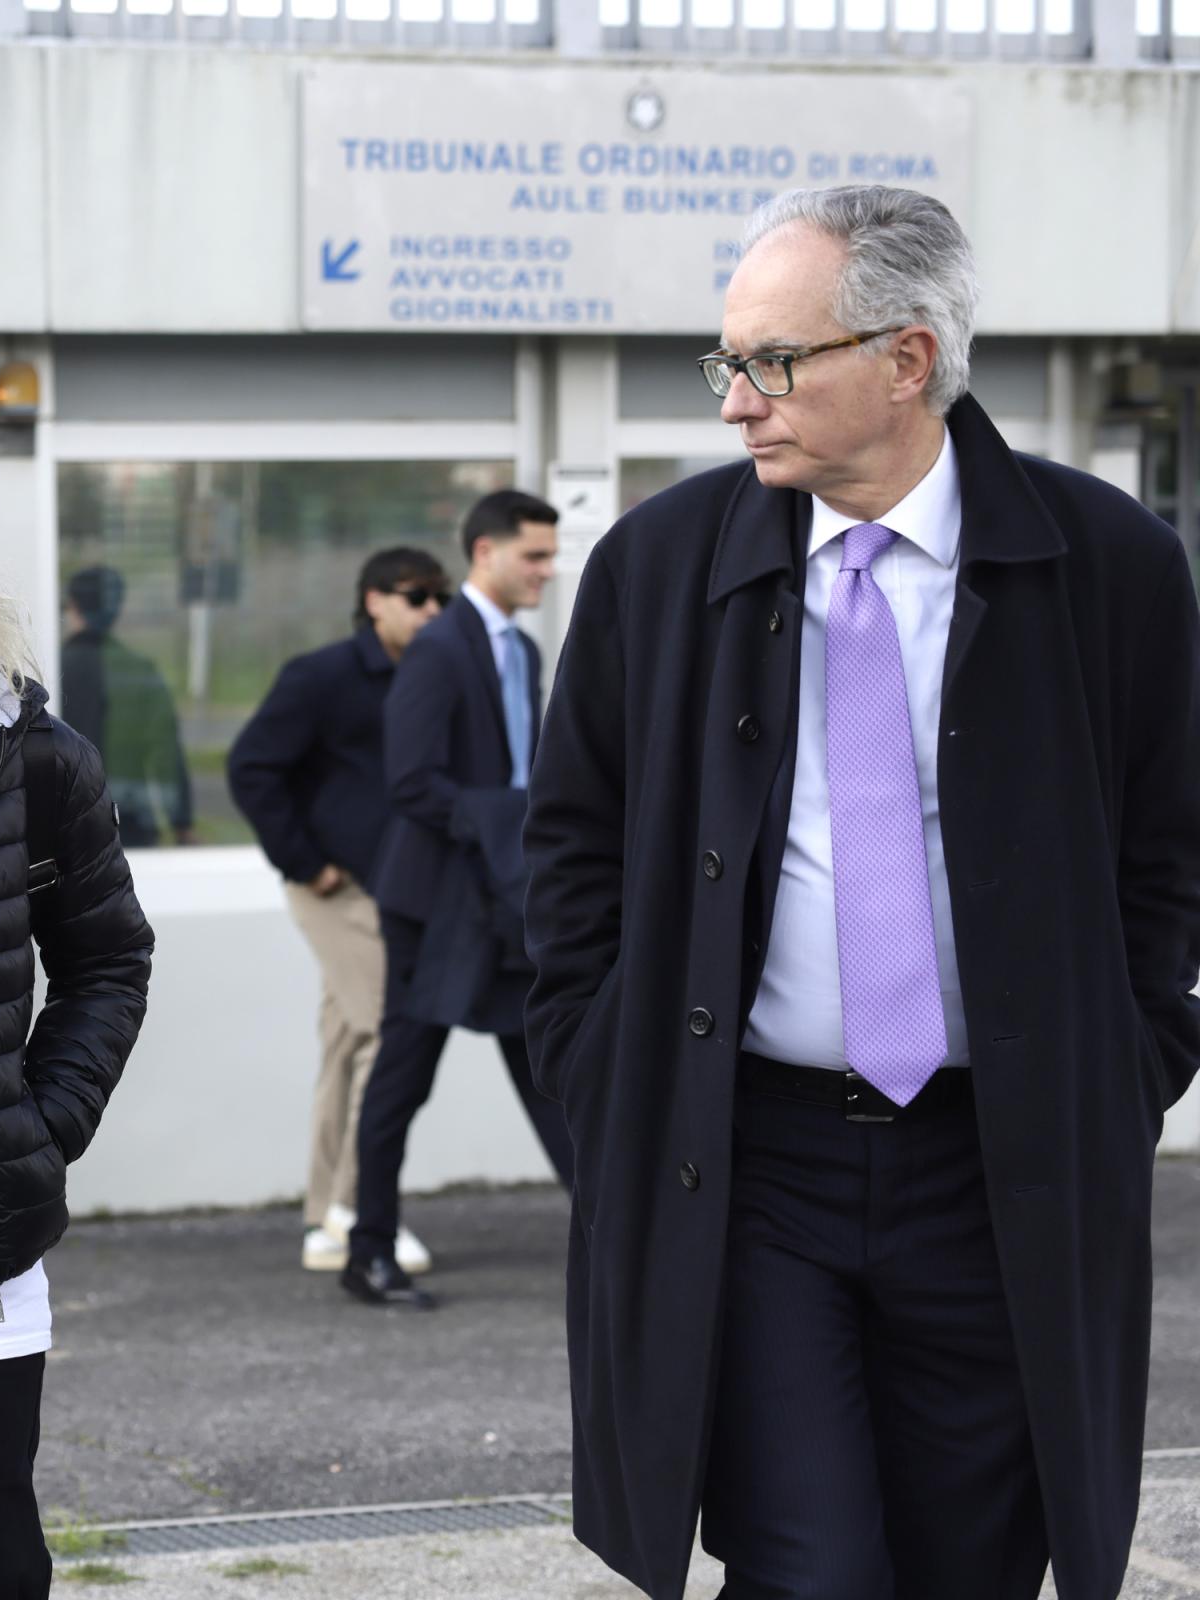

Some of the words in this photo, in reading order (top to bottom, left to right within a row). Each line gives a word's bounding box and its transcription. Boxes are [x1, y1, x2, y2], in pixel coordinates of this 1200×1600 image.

[341, 138, 563, 175] TRIBUNALE
[578, 142, 795, 179] ORDINARIO
[807, 154, 839, 178] DI
[848, 154, 937, 179] ROMA
[510, 185, 606, 212] AULE
[390, 236, 572, 261] INGRESSO
[390, 266, 564, 291] AVVOCATI
[390, 296, 614, 322] GIORNALISTI
